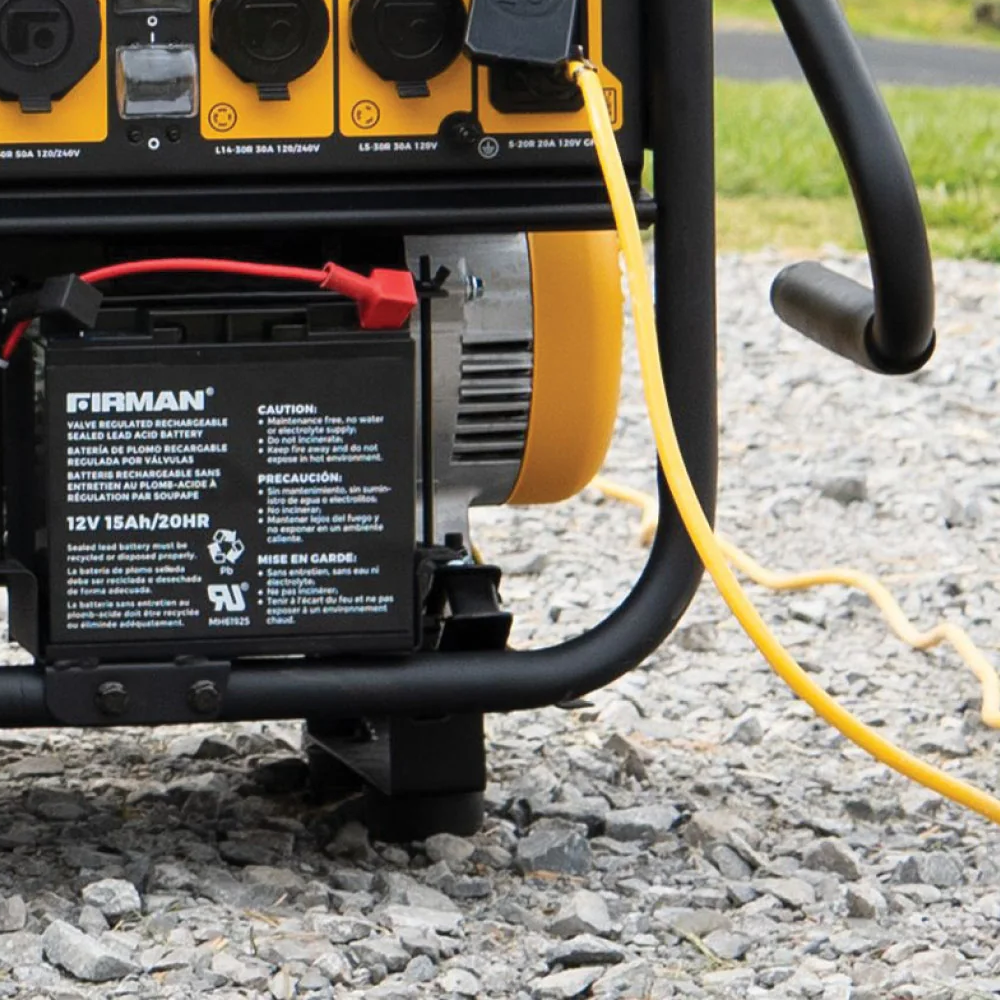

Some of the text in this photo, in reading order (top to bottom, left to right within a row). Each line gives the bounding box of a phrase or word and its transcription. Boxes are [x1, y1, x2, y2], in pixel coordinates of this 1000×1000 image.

[16, 150, 33, 158] 50A
[66, 390, 205, 413] FIRMAN
[258, 405, 317, 414] CAUTION:
[67, 418, 228, 429] VALVE REGULATED RECHARGEABLE
[67, 429, 203, 440] SEALED LEAD ACID BATTERY
[164, 445, 227, 453] RECARGABLE
[68, 457, 119, 466] REGULADA
[122, 456, 142, 465] POR
[116, 469, 191, 479] RECHARGEABLE
[195, 469, 220, 477] SANS
[258, 472, 343, 483] PRECAUCIÓN:
[68, 482, 121, 490] ENTRETIEN
[140, 480, 206, 489] PLOMB-ACIDE
[132, 492, 151, 500] PAR
[154, 491, 198, 500] SOUPAPE
[67, 513, 209, 531] 12V 15Ah/20HR
[258, 554, 356, 564] MISE EN GARDE:
